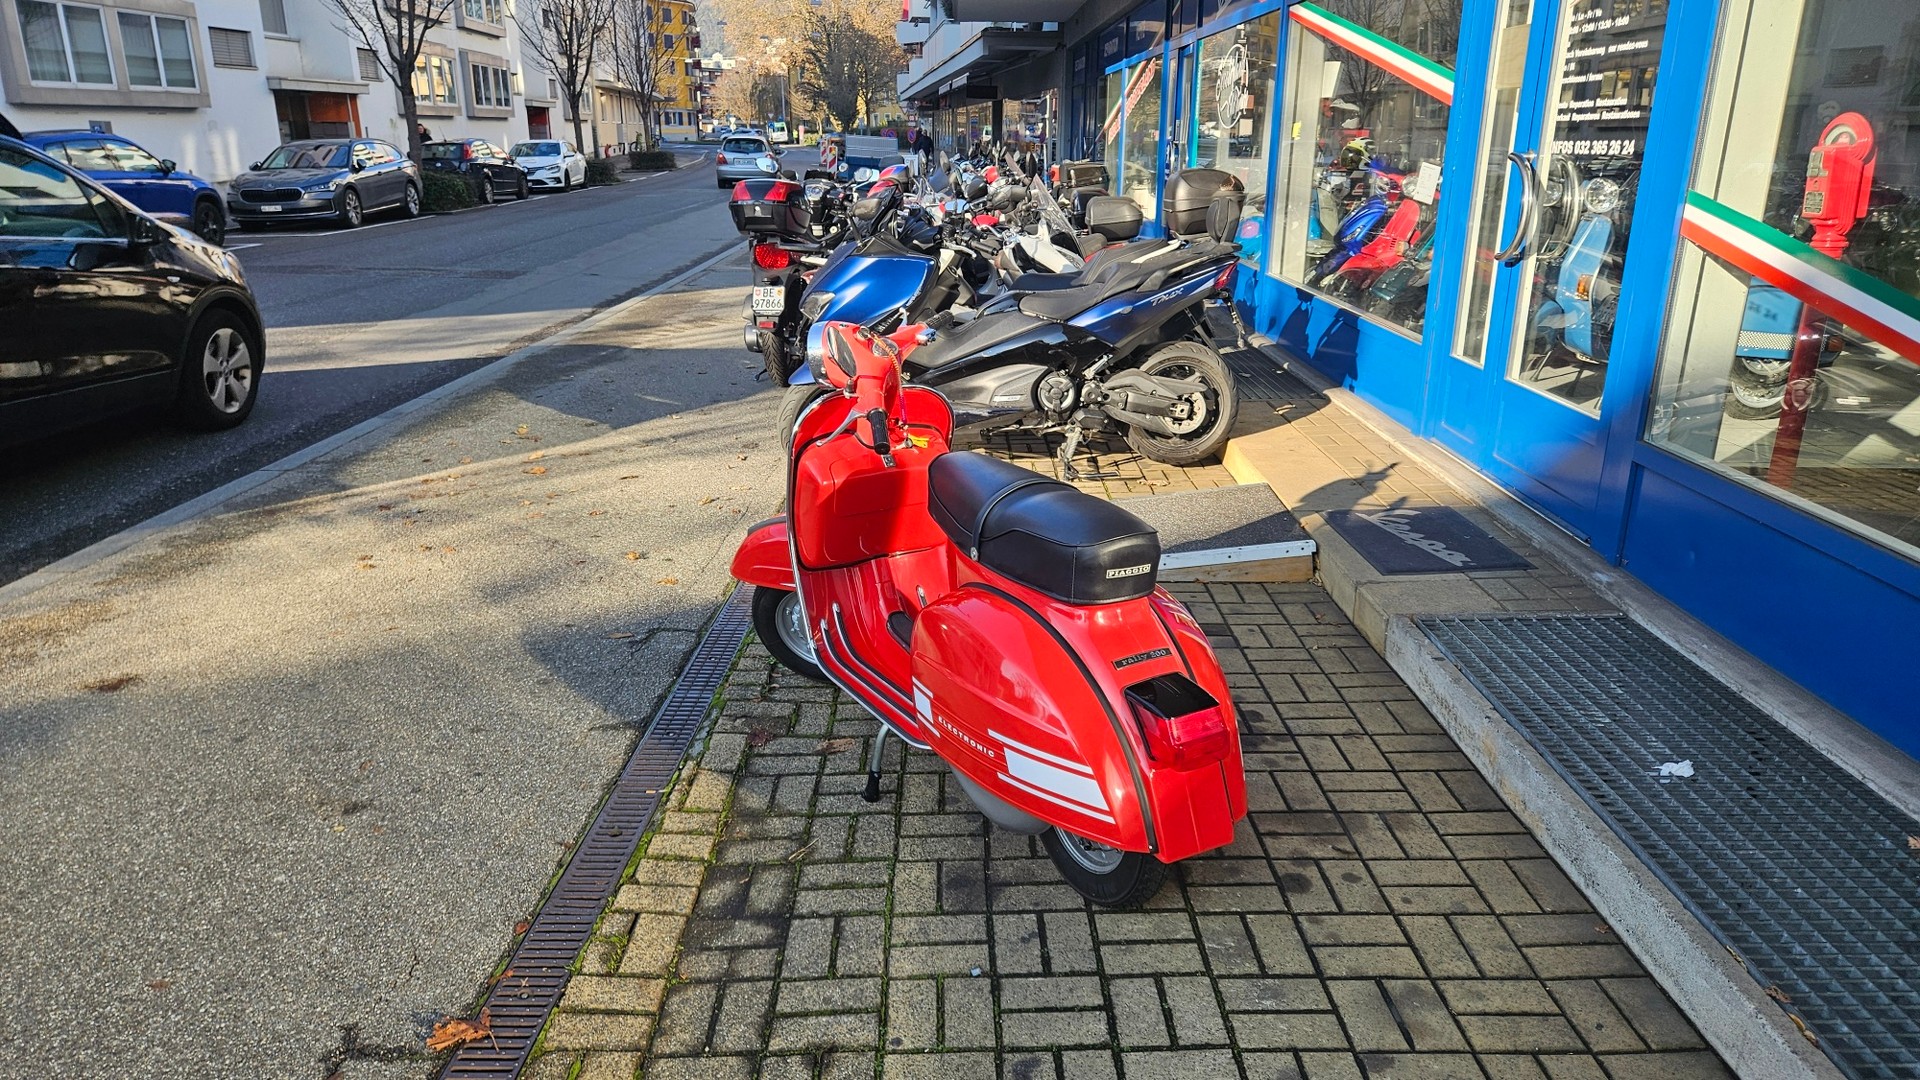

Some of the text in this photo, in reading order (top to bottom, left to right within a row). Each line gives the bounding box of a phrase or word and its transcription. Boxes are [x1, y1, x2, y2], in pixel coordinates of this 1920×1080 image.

[1556, 112, 1571, 121] erkauf
[1552, 139, 1636, 155] NFOS 032 365 26 24
[762, 288, 774, 298] BE
[754, 299, 782, 309] 97866
[1355, 509, 1473, 567] Vespa
[1107, 564, 1150, 578] PIAGGIO
[1121, 649, 1167, 665] rally 200
[938, 716, 995, 757] ELECTRONIC
